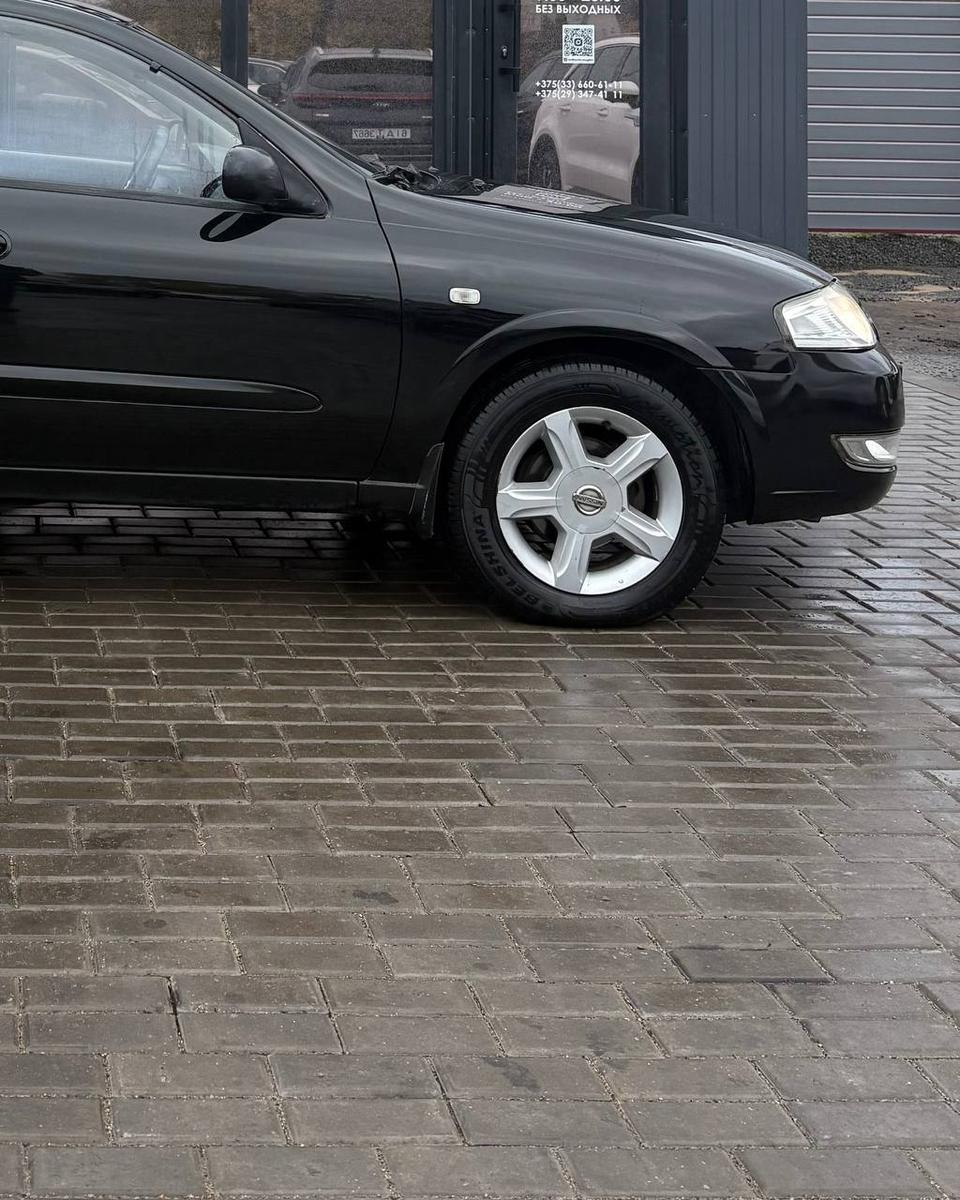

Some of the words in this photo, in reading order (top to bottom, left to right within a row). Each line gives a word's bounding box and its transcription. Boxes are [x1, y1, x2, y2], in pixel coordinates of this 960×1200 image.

[536, 4, 553, 14] БЕЗ
[557, 4, 621, 15] ВЫХОДНЫХ
[535, 80, 575, 90] +375(33)
[577, 80, 622, 89] 660-61-11
[535, 90, 575, 100] +375(29)
